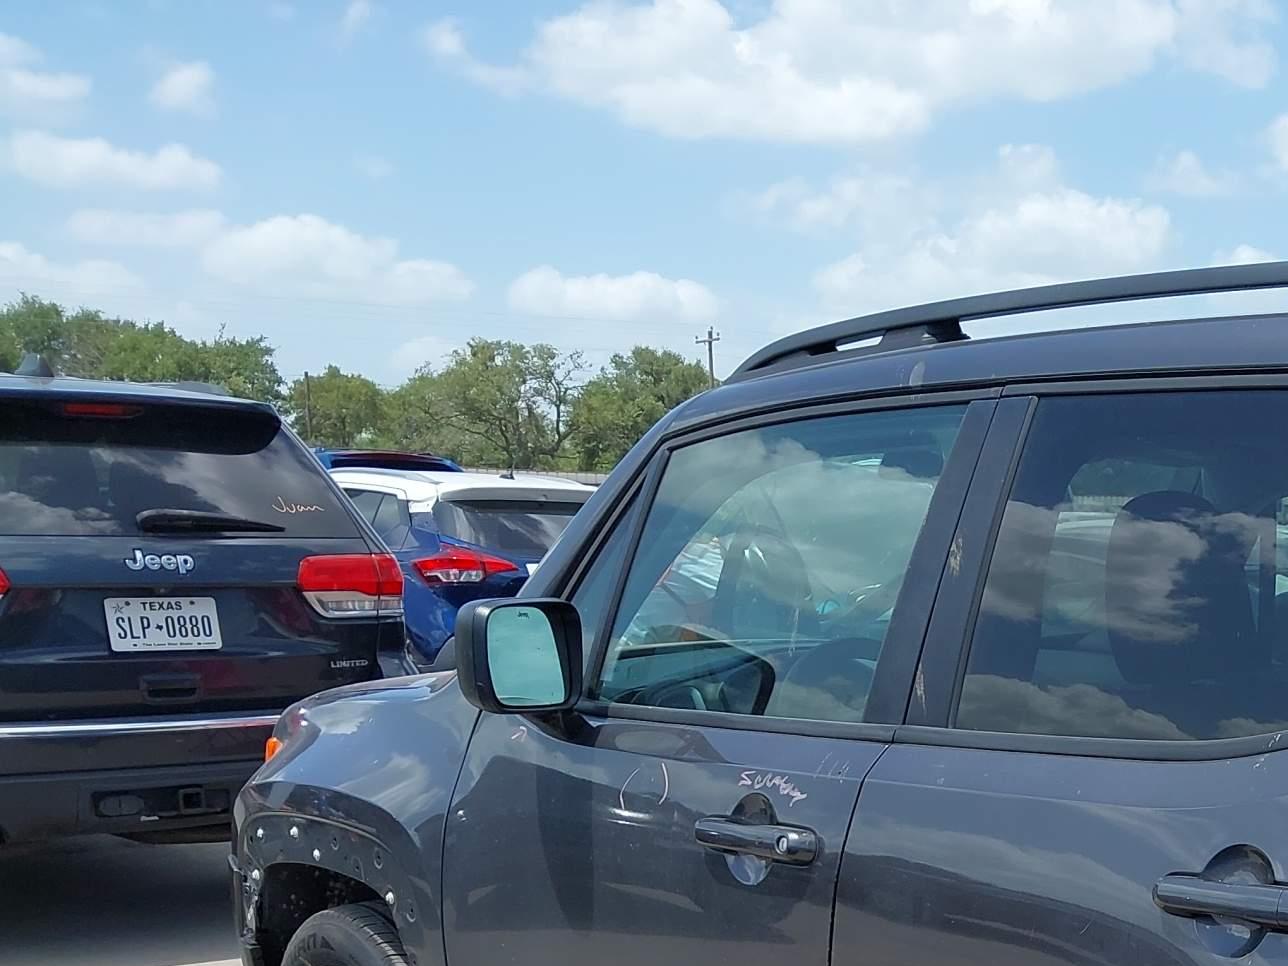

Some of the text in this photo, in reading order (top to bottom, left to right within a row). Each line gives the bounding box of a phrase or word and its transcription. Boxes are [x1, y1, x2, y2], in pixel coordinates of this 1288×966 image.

[125, 548, 195, 574] Jeep
[140, 601, 183, 612] TEXAS
[330, 659, 369, 668] LIMITED
